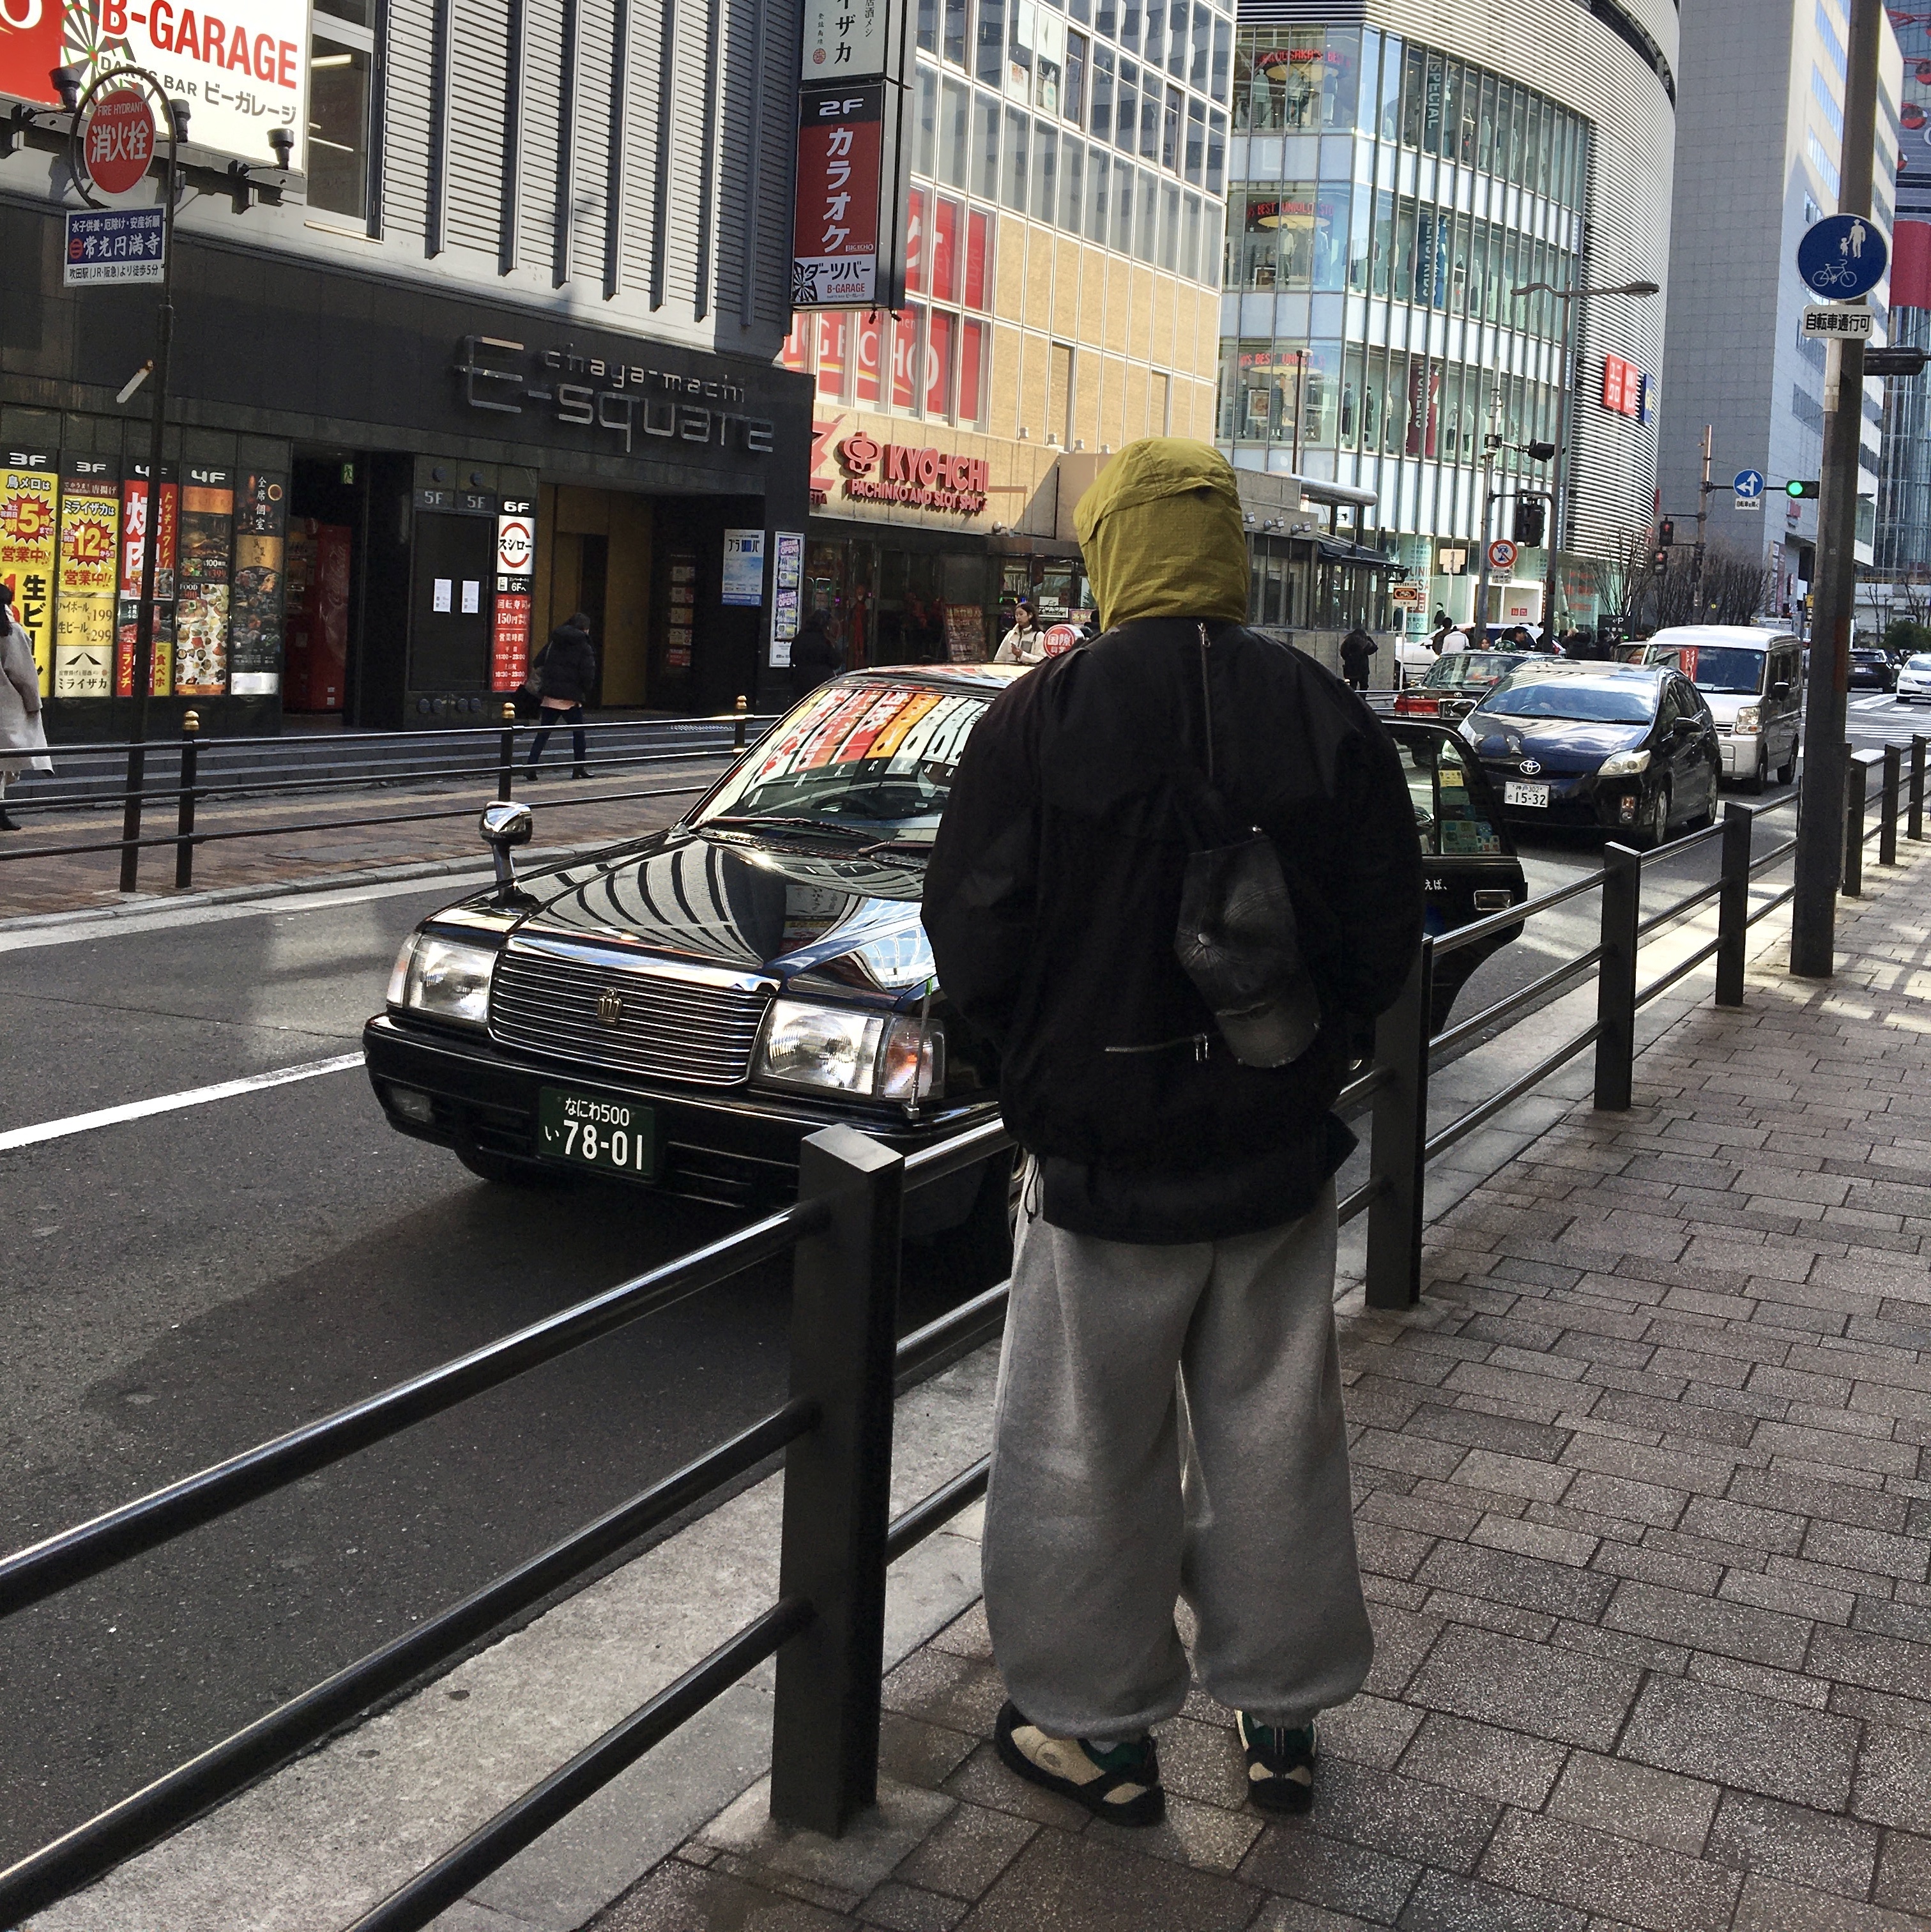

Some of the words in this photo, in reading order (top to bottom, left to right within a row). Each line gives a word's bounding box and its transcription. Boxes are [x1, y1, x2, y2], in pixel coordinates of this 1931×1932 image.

[102, 0, 298, 89] B-GARAGE
[164, 75, 197, 96] BAR
[204, 81, 297, 125] ビーガレージ
[819, 98, 864, 116] 2F
[1428, 65, 1442, 129] SPECIAL
[98, 104, 112, 117] FIRE
[114, 101, 144, 115] HYDRANT
[91, 119, 149, 164] 消火栓
[821, 128, 853, 253] カラオケ
[84, 231, 160, 259] 常光円満寺
[805, 261, 871, 282] ダーツバー
[827, 283, 865, 293] B-GARAGE
[1806, 312, 1871, 332] 自転車通行可
[544, 343, 745, 402] chaya-machi
[454, 335, 774, 452] E-square
[10, 452, 47, 466] 3F
[76, 461, 107, 473] 3F
[889, 445, 990, 493] KYO-ICHI
[7, 475, 50, 491] 鳥メロは
[192, 470, 226, 483] 4F
[256, 476, 266, 531] 全席個室
[425, 491, 443, 505] 5F
[467, 495, 485, 509] 5F
[851, 479, 908, 503] PACHINKO
[910, 488, 932, 505] AND
[934, 492, 958, 509] SLOT
[64, 500, 116, 516] ミライザカは
[504, 502, 530, 513] 6F
[498, 539, 533, 551] スシロー
[57, 622, 88, 634] 生ビール
[121, 654, 132, 688] ランチ
[59, 678, 107, 689] ミライザカ
[1516, 792, 1546, 806] 15-32
[565, 1098, 630, 1126] なにわ500
[545, 1126, 560, 1141] い
[563, 1119, 643, 1170] 78-01
